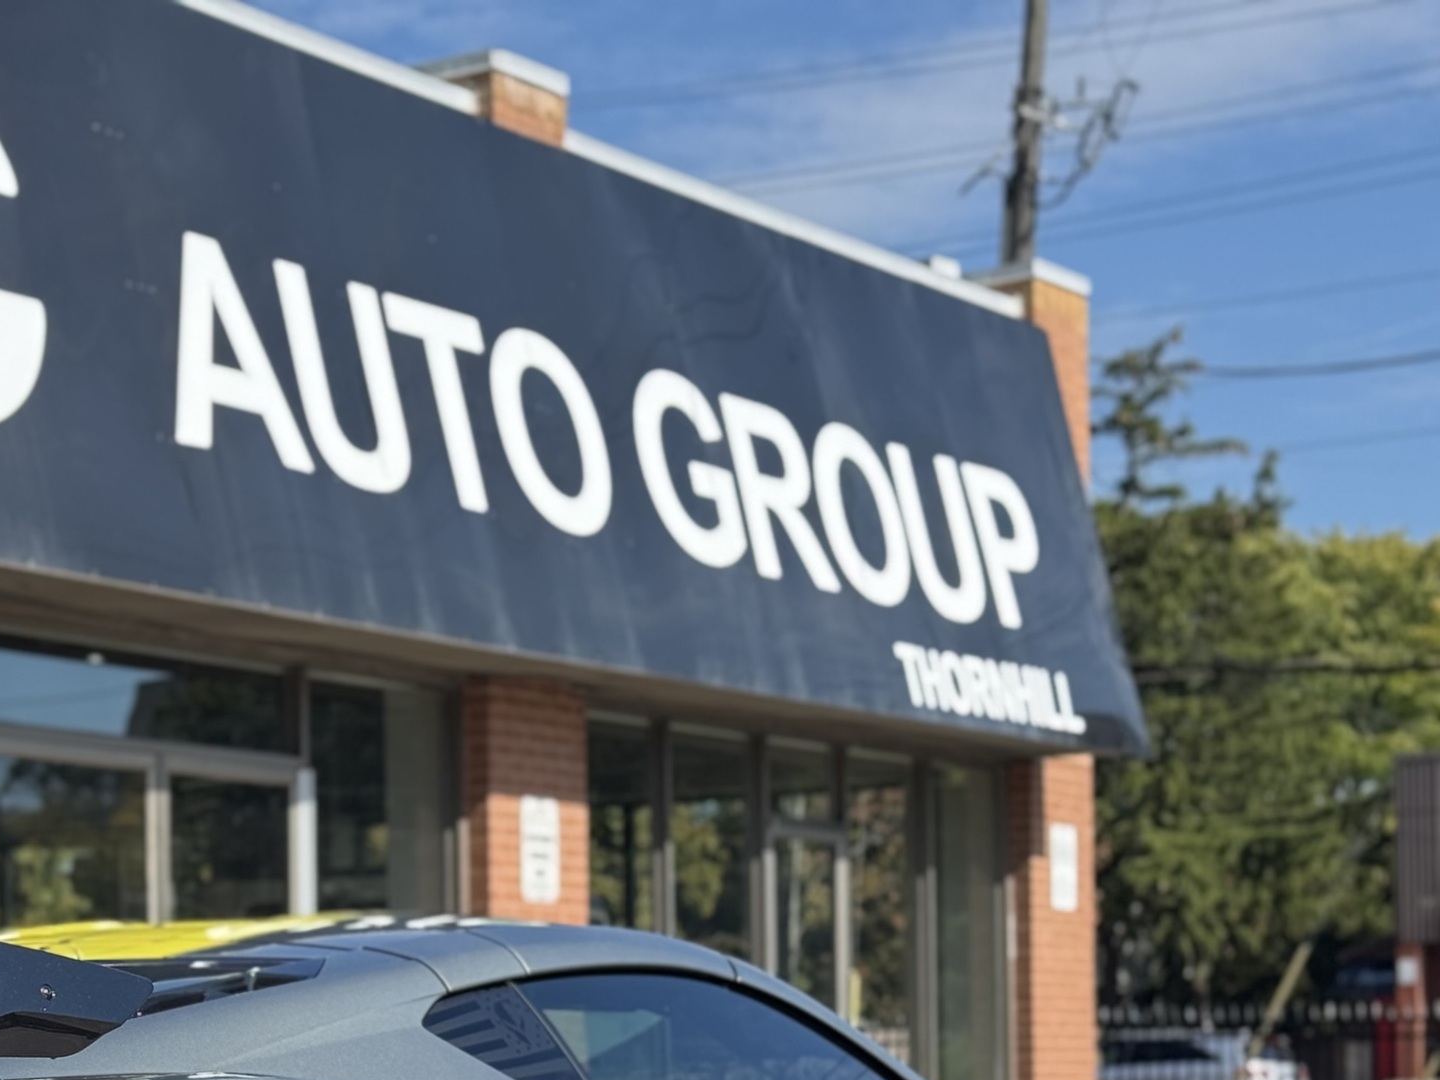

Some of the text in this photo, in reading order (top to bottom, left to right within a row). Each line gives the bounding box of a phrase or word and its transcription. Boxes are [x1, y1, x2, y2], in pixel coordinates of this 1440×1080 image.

[174, 230, 612, 537] AUTO
[633, 368, 1039, 629] GROUP
[892, 640, 1087, 735] THORNHILL
